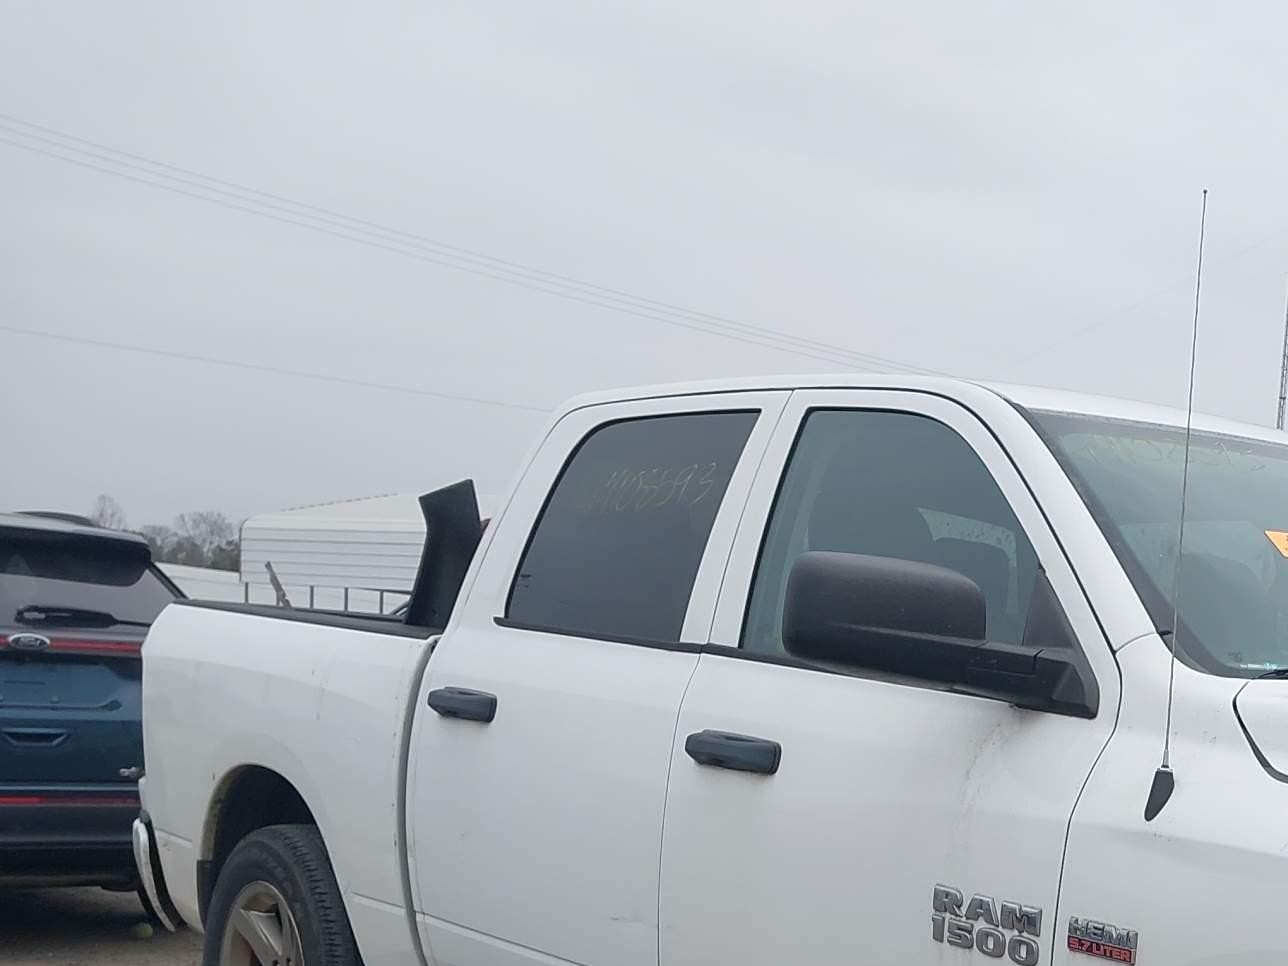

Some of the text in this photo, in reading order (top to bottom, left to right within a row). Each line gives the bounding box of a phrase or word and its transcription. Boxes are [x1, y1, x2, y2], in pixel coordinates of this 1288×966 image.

[932, 883, 1043, 937] RAM
[931, 913, 1040, 966] 1500
[1068, 915, 1139, 950] HEMI
[1069, 937, 1132, 963] 5.7 LITER
